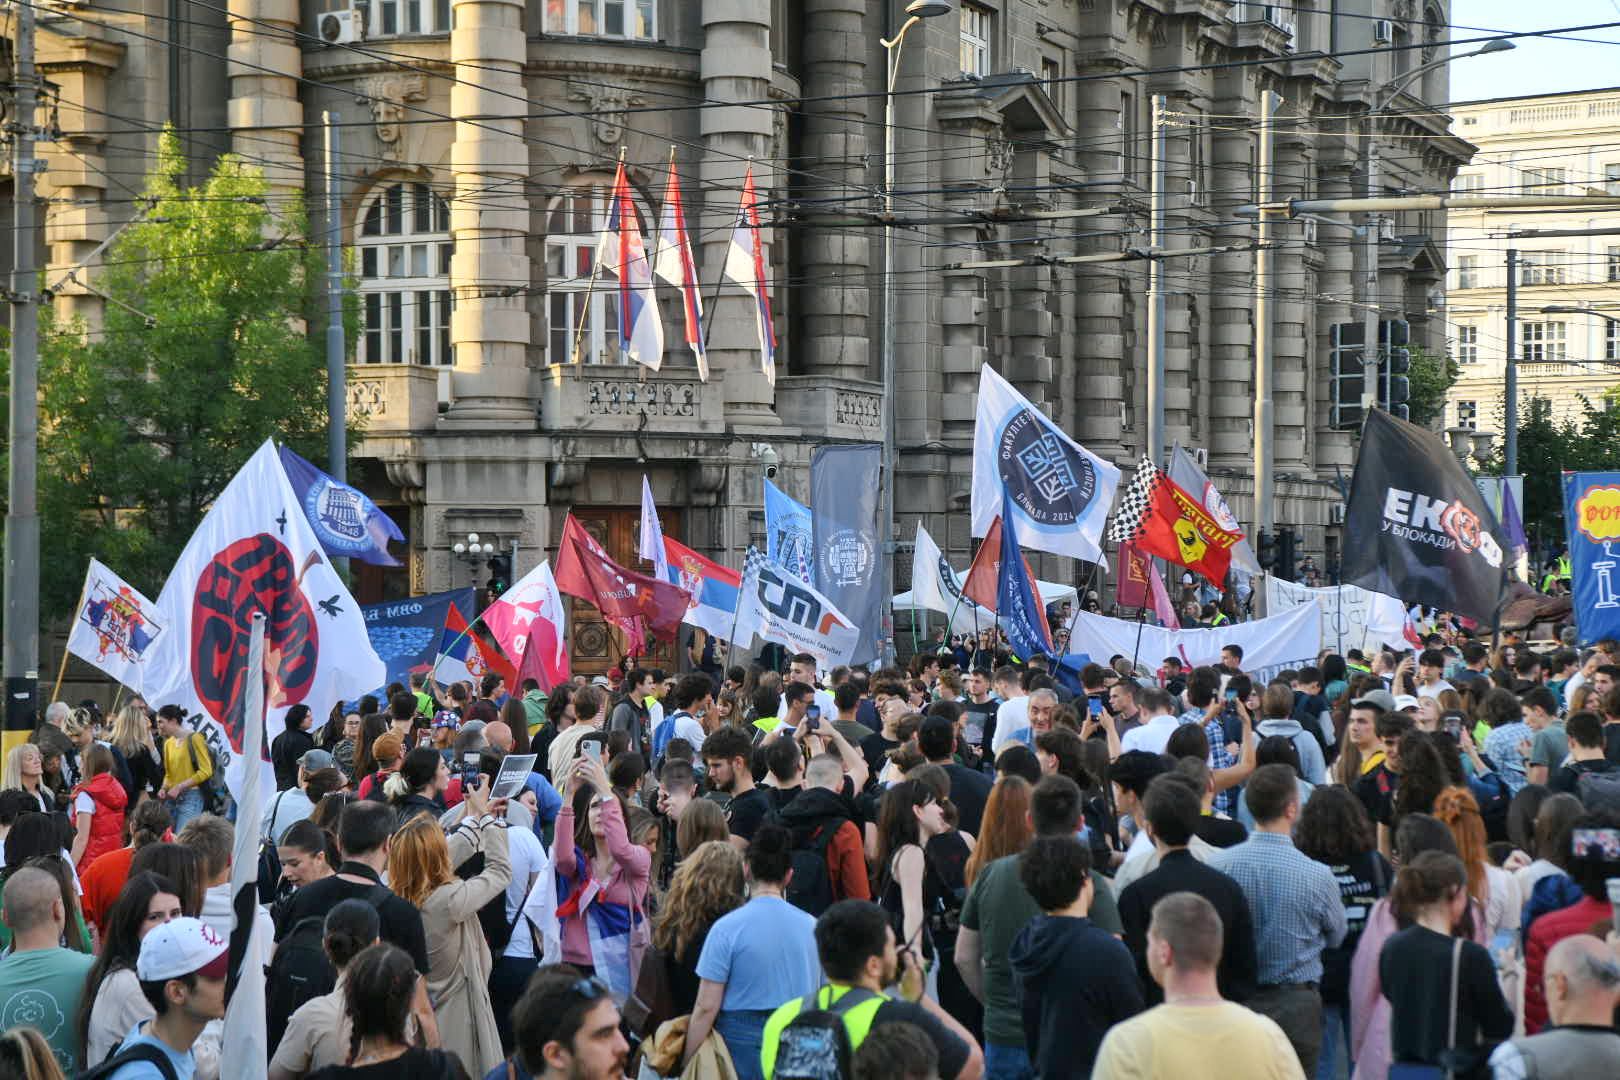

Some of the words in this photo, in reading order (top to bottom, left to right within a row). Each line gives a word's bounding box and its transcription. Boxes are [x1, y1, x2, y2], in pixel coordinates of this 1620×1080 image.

[1052, 511, 1075, 521] 2024
[336, 523, 360, 537] 1948
[1381, 519, 1392, 532] У
[1392, 523, 1457, 550] БЛОКАДИ
